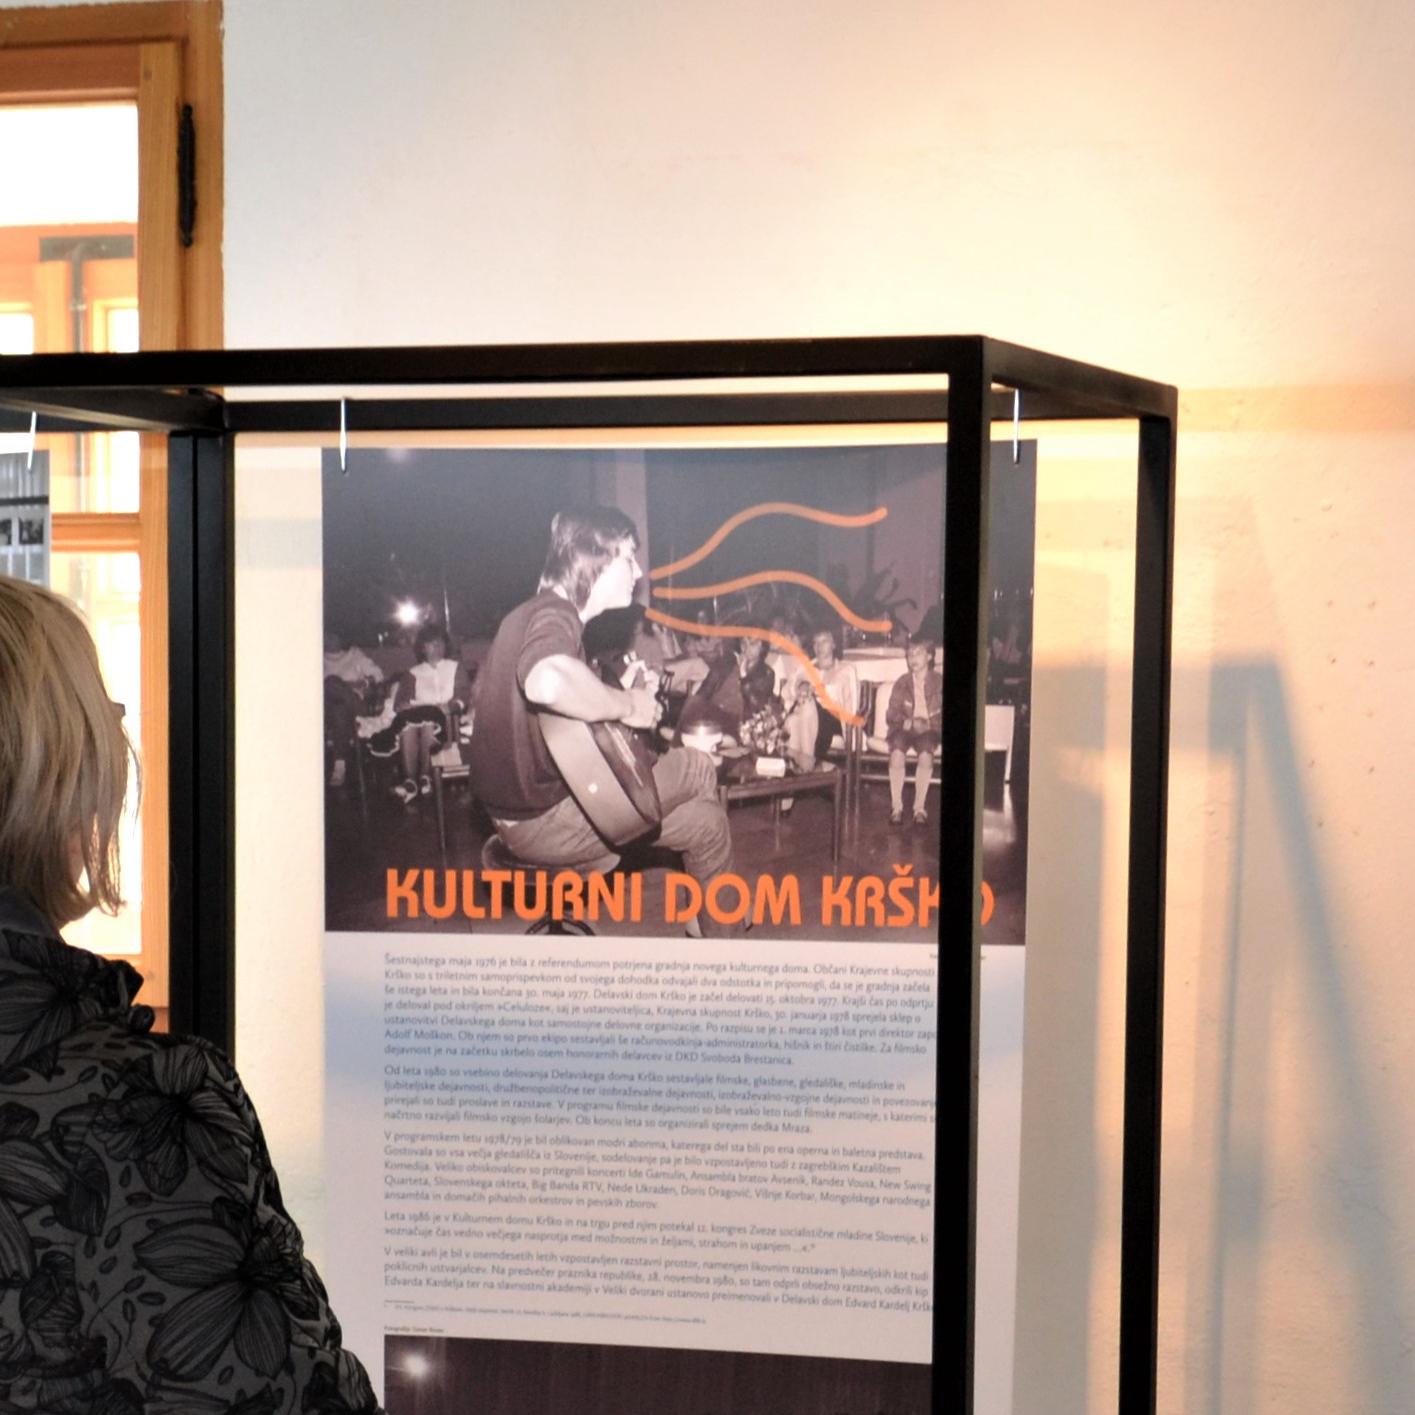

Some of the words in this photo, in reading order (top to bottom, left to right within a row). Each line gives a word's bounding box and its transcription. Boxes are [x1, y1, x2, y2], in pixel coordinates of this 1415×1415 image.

[385, 868, 642, 922] KULTURNI
[665, 871, 802, 926] DOM
[820, 863, 995, 927] KRŠK
[384, 952, 446, 968] Šestnajstega
[448, 954, 472, 968] maja
[498, 955, 507, 969] je
[509, 955, 527, 967] bila
[537, 956, 610, 969] referendumom
[611, 957, 653, 972] potrjena
[654, 958, 691, 973] gradnja
[692, 962, 727, 974] novega
[729, 960, 779, 975] kulturnega
[813, 962, 847, 974] Občani
[849, 962, 889, 977] Krajevne
[891, 963, 935, 978] skupnosti
[384, 968, 411, 979] Krško
[413, 971, 425, 980] so
[435, 969, 478, 981] triletnim
[479, 970, 562, 986] samoprispevkom
[563, 972, 577, 983] od
[579, 972, 615, 987] svojega
[617, 973, 659, 985] dohodka
[661, 974, 698, 989] odvajali
[699, 975, 717, 986] dva
[719, 975, 761, 987] odstotka
[763, 976, 772, 987] in
[829, 977, 841, 989] da
[843, 980, 853, 989] se
[855, 978, 863, 992] je
[865, 978, 900, 993] gradnja
[902, 979, 930, 991] začela
[383, 1042, 431, 1057] dejavnost
[433, 1043, 443, 1057] je
[445, 1046, 457, 1055] na
[460, 1044, 497, 1056] začetku
[500, 1045, 535, 1057] skrbelo
[537, 1049, 564, 1058] osem
[565, 1047, 619, 1059] honorarnih
[621, 1048, 663, 1061] delavcev
[664, 1050, 672, 1061] iz
[675, 1050, 699, 1062] DKD
[700, 1051, 741, 1063] Svoboda
[383, 1063, 401, 1075] Od
[402, 1064, 421, 1075] leta
[449, 1068, 460, 1077] so
[462, 1066, 500, 1078] vsebino
[502, 1067, 549, 1082] delovanja
[551, 1068, 605, 1084] Delavskega
[607, 1070, 635, 1082] doma
[637, 1071, 663, 1083] Krško
[665, 1072, 713, 1087] sestavljale
[848, 1077, 894, 1090] mladinske
[896, 1078, 905, 1090] in
[433, 1174, 493, 1190] Slovenskega
[531, 1178, 547, 1192] Big
[549, 1178, 579, 1191] Banda
[607, 1180, 633, 1193] Nede
[680, 1183, 706, 1195] Doris
[754, 1186, 782, 1201] Višnje
[819, 1189, 880, 1205] Mongolskega
[882, 1191, 931, 1207] narodnega
[434, 1159, 464, 1171] Veliko
[465, 1160, 527, 1174] obiskovalcev
[528, 1165, 540, 1174] so
[541, 1163, 585, 1179] pritegnili
[586, 1165, 625, 1177] koncerti
[689, 1169, 736, 1181] Ansambla
[737, 1170, 769, 1183] bratov
[810, 1173, 845, 1186] Randez
[879, 1176, 901, 1188] New
[903, 1176, 931, 1192] Swing
[383, 1258, 428, 1274] poklicnih
[491, 1263, 505, 1275] Na
[507, 1264, 555, 1280] predvečer
[557, 1266, 597, 1282] praznika
[663, 1271, 710, 1284] novembra
[739, 1277, 750, 1286] so
[752, 1276, 771, 1287] tam
[772, 1276, 800, 1291] odprli
[801, 1277, 840, 1290] obsežno
[883, 1281, 913, 1293] odkrili
[914, 1282, 929, 1297] kip
